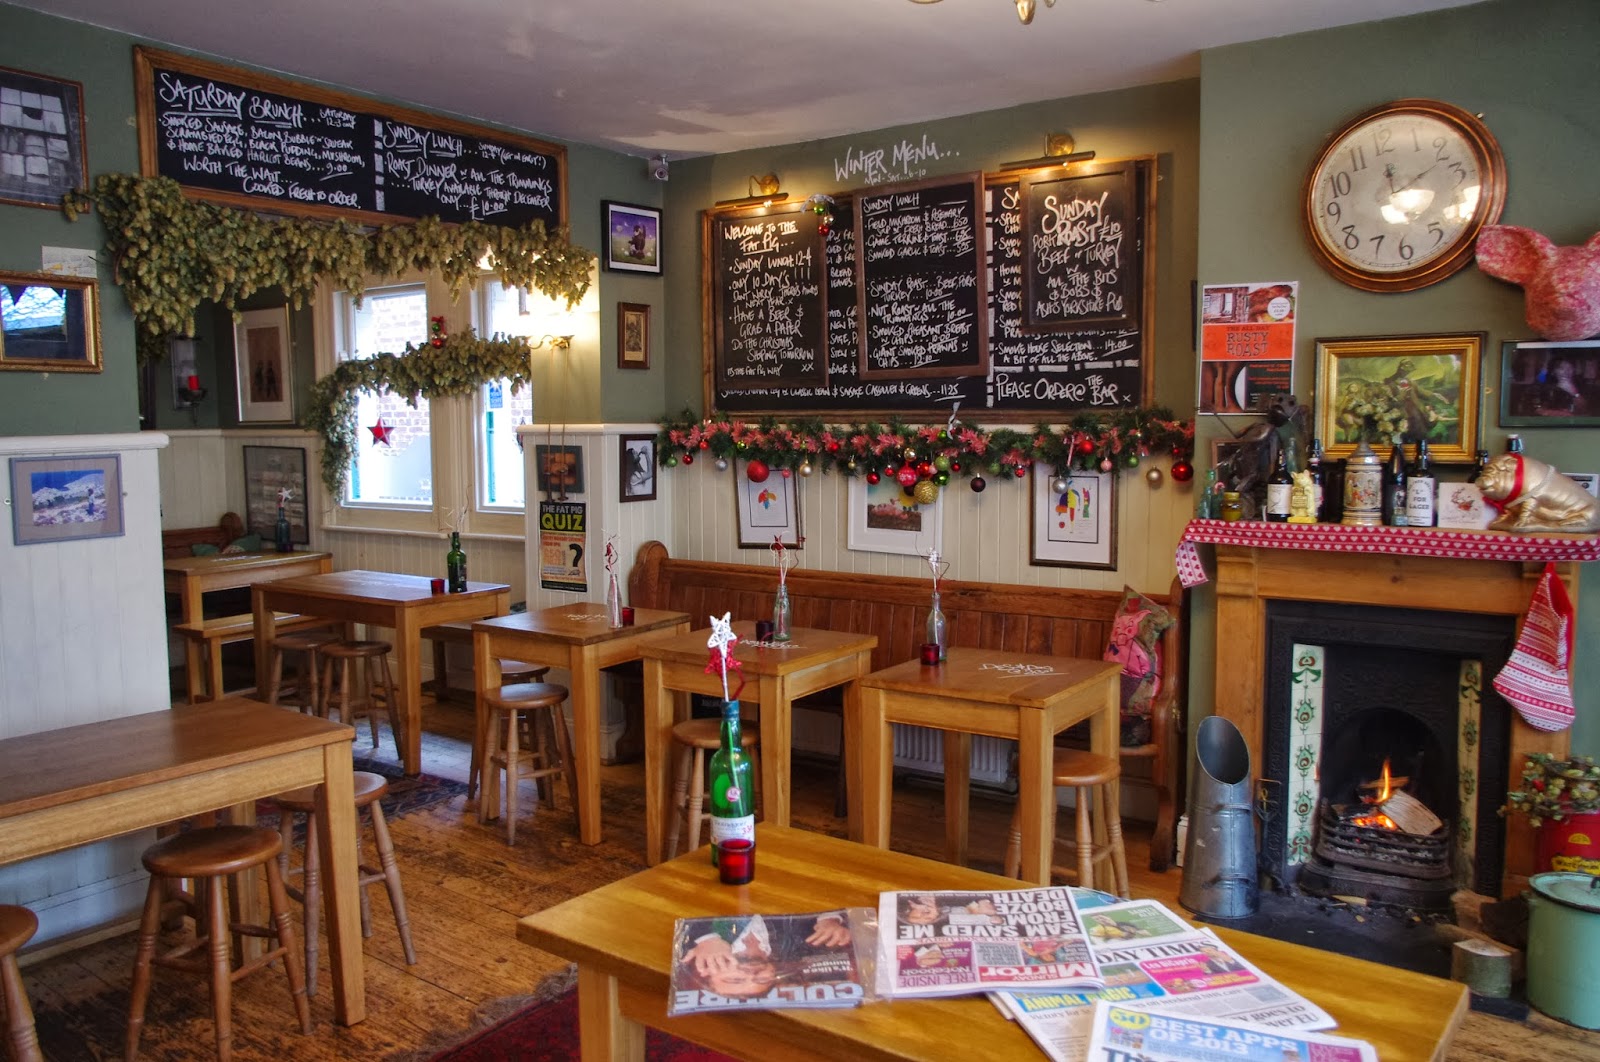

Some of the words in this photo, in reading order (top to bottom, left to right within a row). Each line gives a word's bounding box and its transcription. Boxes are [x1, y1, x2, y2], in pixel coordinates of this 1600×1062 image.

[160, 73, 246, 119] SATURDAY
[320, 108, 356, 121] SATURDAY
[162, 114, 202, 130] SMOKED
[284, 131, 315, 144] BUBBLE
[322, 137, 353, 149] SQUEAK
[382, 121, 430, 158] SUNDAY
[1410, 128, 1421, 152] 1
[249, 139, 279, 152] BLACK
[479, 142, 501, 154] SUNDAY
[1371, 128, 1395, 156] 12
[1432, 137, 1450, 162] 2
[178, 139, 205, 153] HOME
[206, 142, 243, 159] BAKED
[247, 149, 281, 164] HARICOT
[326, 162, 347, 175] 9.00
[834, 146, 887, 182] WINTER
[1350, 147, 1367, 172] 11
[184, 155, 222, 175] WORTH
[225, 161, 248, 178] THE
[387, 152, 415, 181] ROAST
[417, 156, 459, 184] DINNER
[470, 168, 487, 182] ALL
[486, 170, 505, 185] THE
[506, 172, 552, 196] TRIMMINGS
[1448, 161, 1467, 188] 3
[243, 176, 285, 196] COOKED
[289, 182, 316, 201] FRESH
[317, 190, 327, 200] TO
[1329, 171, 1351, 199] 10
[444, 182, 482, 196] AVAILABLE
[514, 191, 552, 211] DECEMBER
[863, 194, 894, 213] SUNDAY
[895, 193, 919, 207] LUNCH
[1042, 191, 1108, 234] SUNDAY
[1327, 202, 1341, 225] 9
[725, 222, 763, 239] WELCOME
[766, 223, 776, 233] TO
[778, 221, 798, 234] THE
[867, 217, 886, 231] FIELD
[889, 215, 920, 227] MUSHROOM
[867, 234, 891, 248] GAME
[1056, 220, 1102, 247] ROAST
[1342, 225, 1359, 250] 8
[1427, 222, 1444, 248] 5
[739, 235, 761, 252] FAT
[1033, 234, 1057, 252] PORK
[1370, 235, 1385, 259] 7
[1399, 233, 1414, 260] 6
[867, 247, 895, 262] SMOKED
[1037, 246, 1070, 274] BEEF
[1084, 237, 1122, 268] TURKEY
[732, 255, 763, 274] SUNDAY
[768, 254, 794, 268] LUNCH
[732, 274, 749, 292] ONLY
[752, 276, 760, 289] 10
[870, 279, 903, 297] SUNDAY
[958, 274, 976, 287] PORK
[1069, 272, 1089, 285] THE
[1093, 269, 1117, 285] BITS
[1061, 283, 1090, 299] BOBS
[734, 305, 754, 324] HAVE
[769, 306, 791, 322] BEER
[871, 304, 888, 317] NUT
[891, 301, 916, 316] ROAST
[921, 302, 937, 312] ALL
[938, 300, 956, 311] THE
[1002, 301, 1017, 312] RED
[1061, 298, 1104, 317] YORKSHIRE
[740, 322, 763, 339] GRAB
[774, 320, 803, 337] PAPER
[830, 320, 846, 330] NEW
[872, 325, 904, 339] SMOKED
[944, 322, 972, 335] BREAST
[731, 339, 743, 350] DO
[744, 338, 757, 349] THE
[759, 336, 794, 350] CHRISTMAS
[1227, 332, 1269, 342] RUSTY
[779, 348, 814, 360] TOMORROW
[873, 346, 897, 359] GIANT
[998, 342, 1026, 355] SMOKE
[1027, 341, 1049, 355] HOUSE
[1105, 339, 1127, 351] 14.00
[1227, 342, 1268, 357] ROAST
[1014, 355, 1027, 365] BIT
[1029, 355, 1039, 364] OF
[1041, 354, 1055, 364] ALL
[1057, 352, 1070, 362] THE
[745, 366, 756, 375] FAT
[757, 364, 766, 376] PIG
[767, 364, 783, 376] WAY
[996, 373, 1032, 401] PLEASE
[1034, 378, 1074, 400] ORDER
[1085, 375, 1104, 386] THE
[1090, 383, 1118, 405] BAR
[542, 505, 555, 513] THE
[556, 505, 570, 513] FAT
[571, 506, 583, 514] PIG
[541, 513, 583, 531] QUIZ
[993, 888, 1066, 904] DEATH
[994, 899, 1070, 915] BOOZE
[1005, 910, 1074, 926] FROM
[899, 925, 935, 939] ME
[942, 924, 1018, 938] SAVED
[1025, 921, 1079, 936] SAM
[1140, 940, 1219, 958] TIMES
[902, 965, 970, 976] Notebook
[943, 972, 976, 985] FREE
[981, 962, 1096, 978] Mirror
[1012, 973, 1057, 982] SUNDAY
[899, 975, 940, 988] INSIDE
[1022, 992, 1087, 1011] ANIMAL
[1251, 1007, 1288, 1020] goes
[1288, 1004, 1306, 1013] to
[1296, 1012, 1320, 1024] EU
[1149, 1016, 1222, 1038] BEST
[1223, 1028, 1298, 1051] APPS
[1149, 1027, 1185, 1041] OF
[1190, 1035, 1248, 1055] 2013
